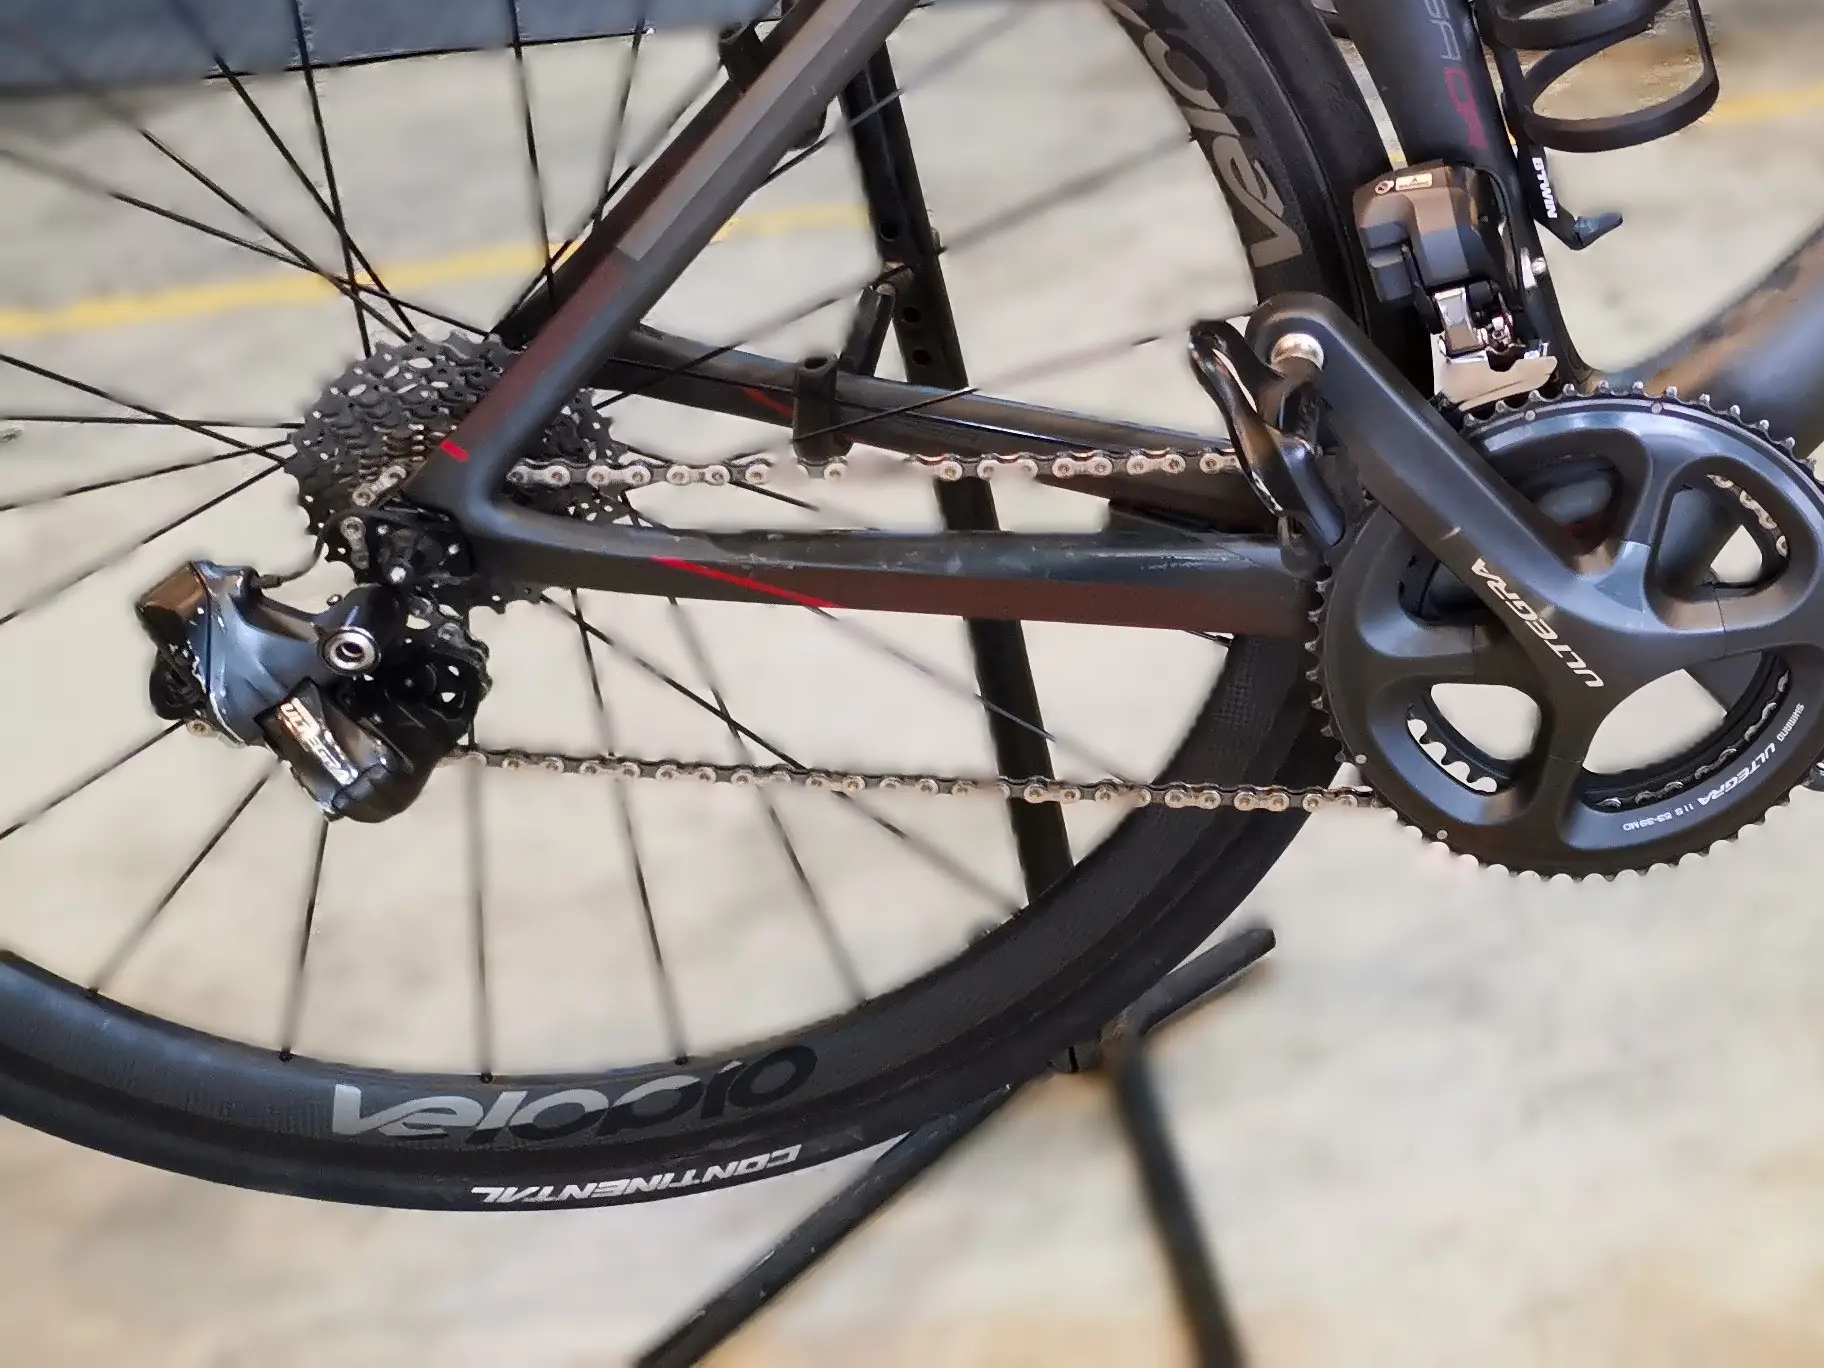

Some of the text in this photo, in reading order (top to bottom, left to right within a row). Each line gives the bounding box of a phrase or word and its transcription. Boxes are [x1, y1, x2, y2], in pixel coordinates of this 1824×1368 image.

[1471, 558, 1605, 688] ULTEGRA
[1776, 703, 1805, 742] SHIMANO
[1697, 742, 1776, 806] ULTEGRA
[471, 1144, 803, 1204] CONTINENTAL
